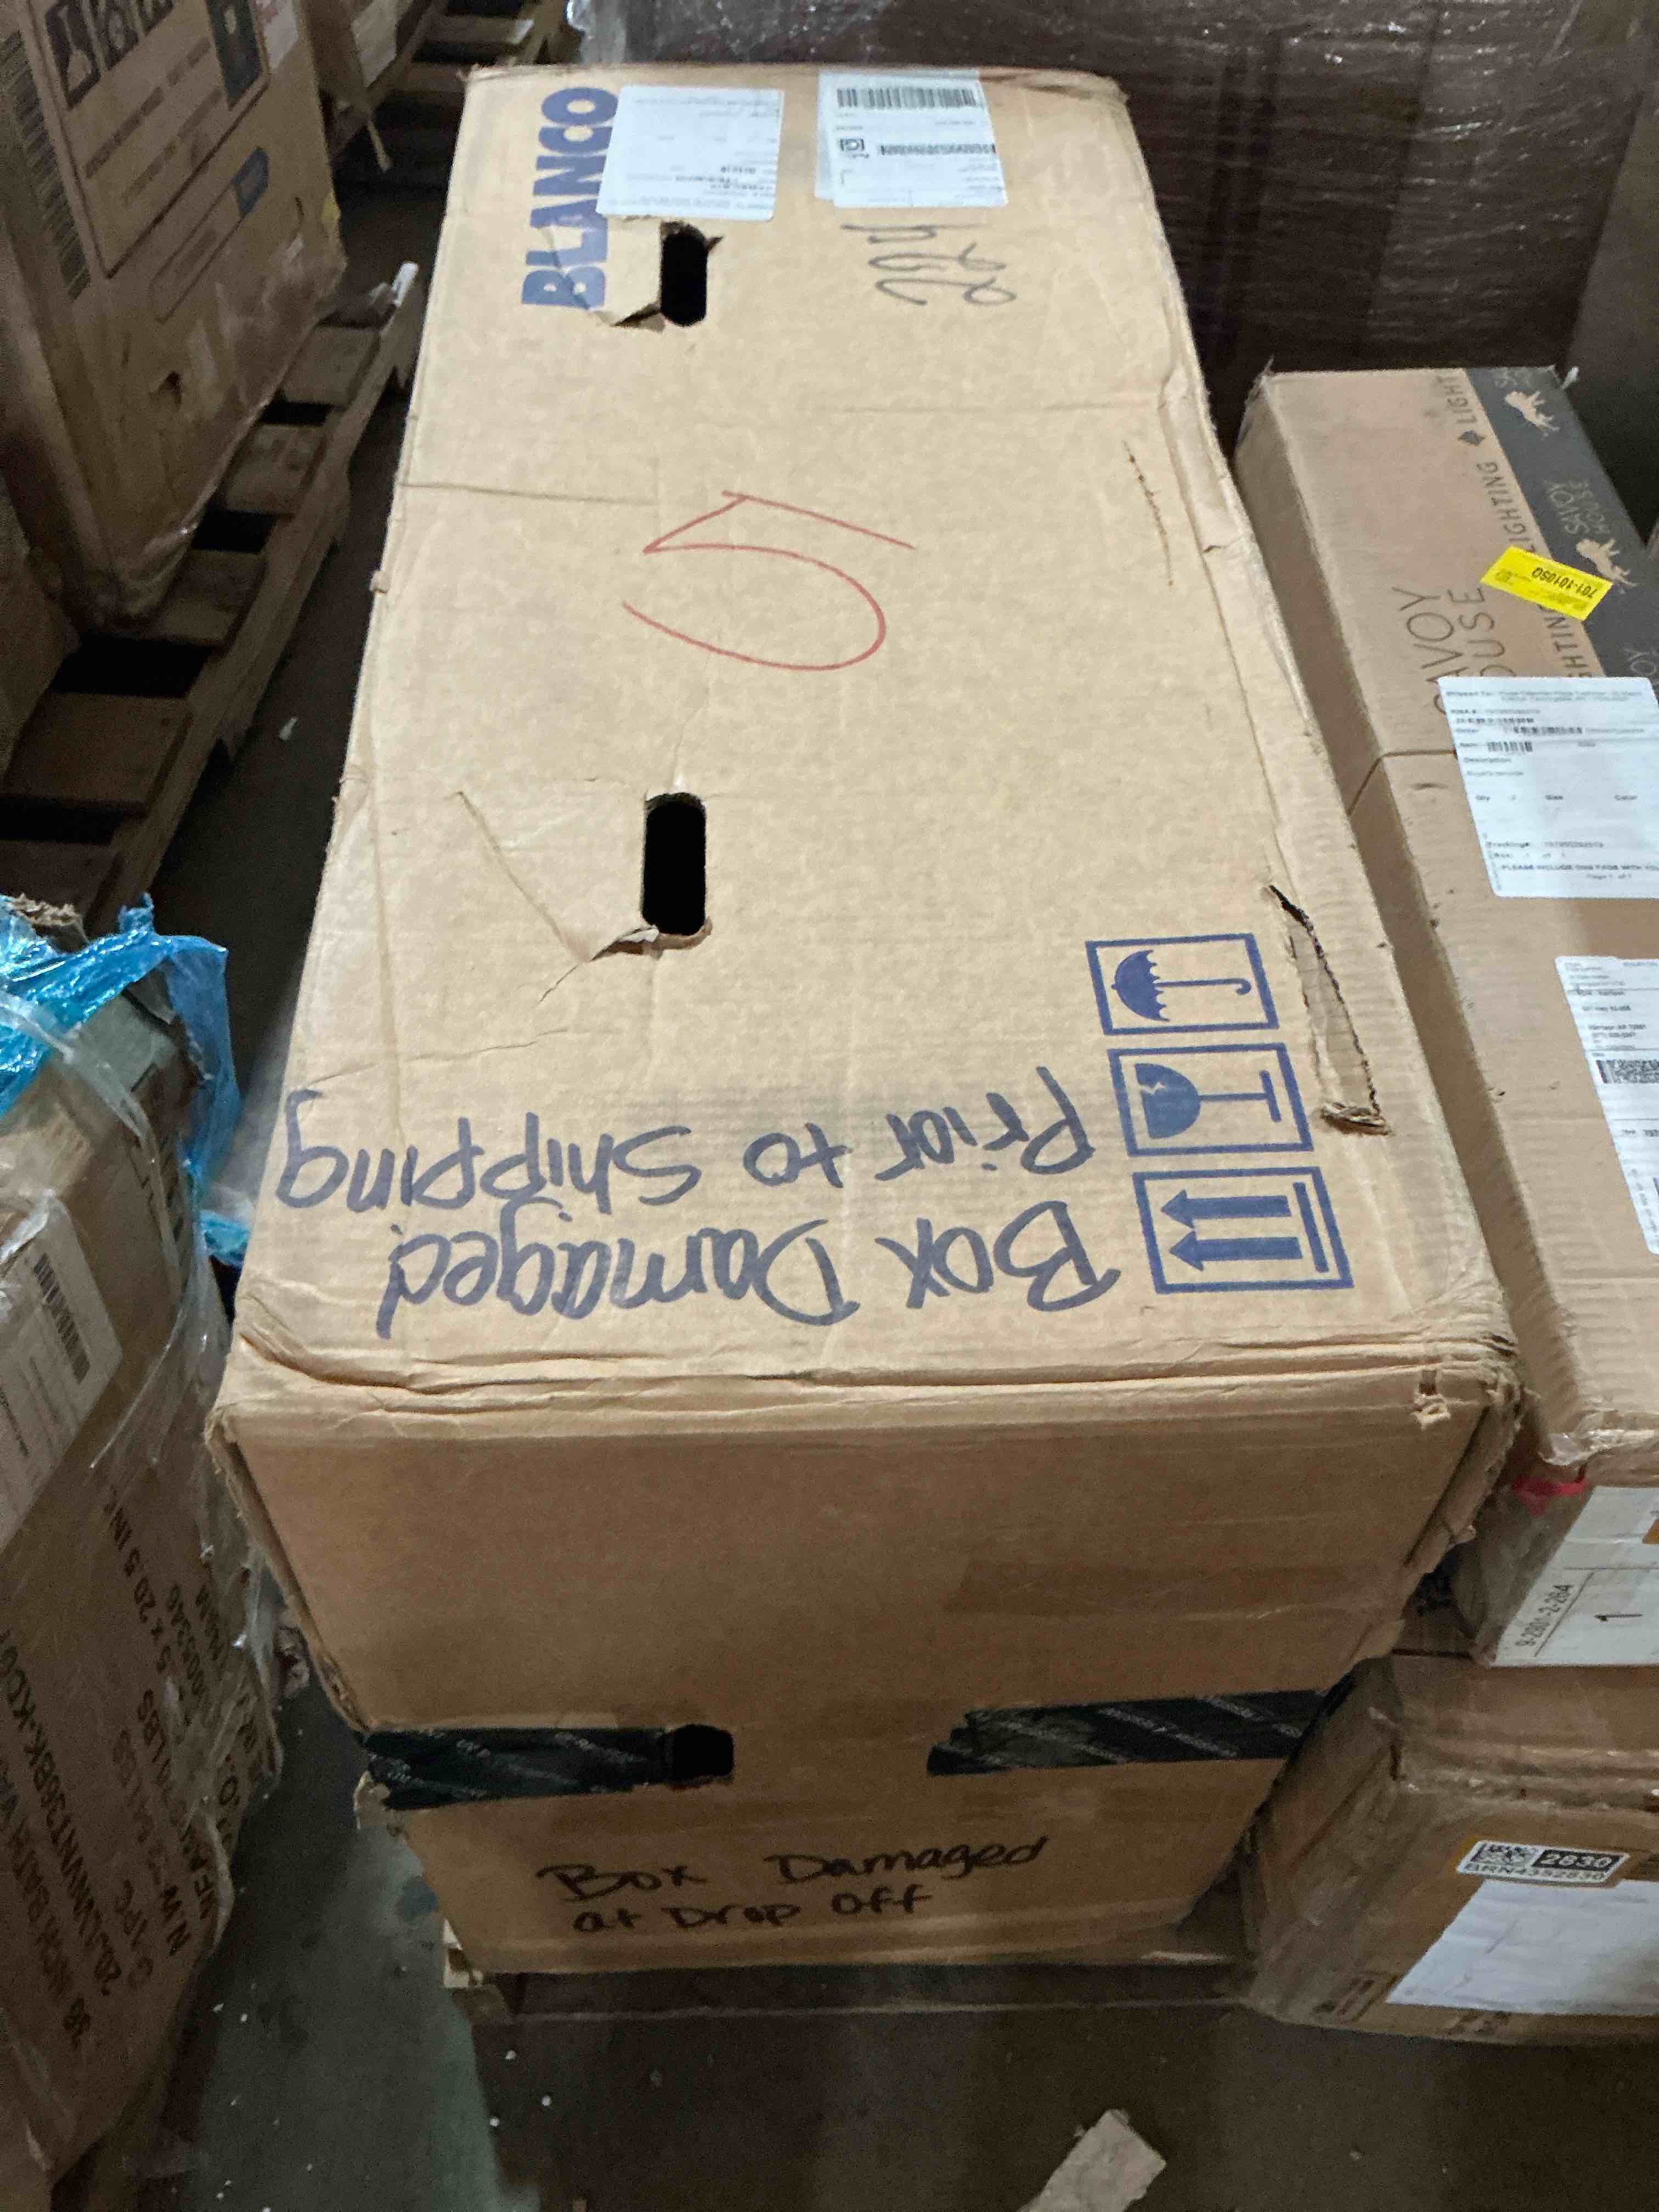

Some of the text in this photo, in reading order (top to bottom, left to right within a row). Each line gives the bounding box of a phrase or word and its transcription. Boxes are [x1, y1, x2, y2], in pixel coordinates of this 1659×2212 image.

[522, 86, 619, 309] BLANCO
[620, 490, 919, 672] 5
[275, 1066, 1095, 1214] Prior to Shipping
[376, 1197, 1121, 1339] Box Damaged
[535, 1834, 1049, 1901] Box Damaged
[572, 1909, 643, 1932] at
